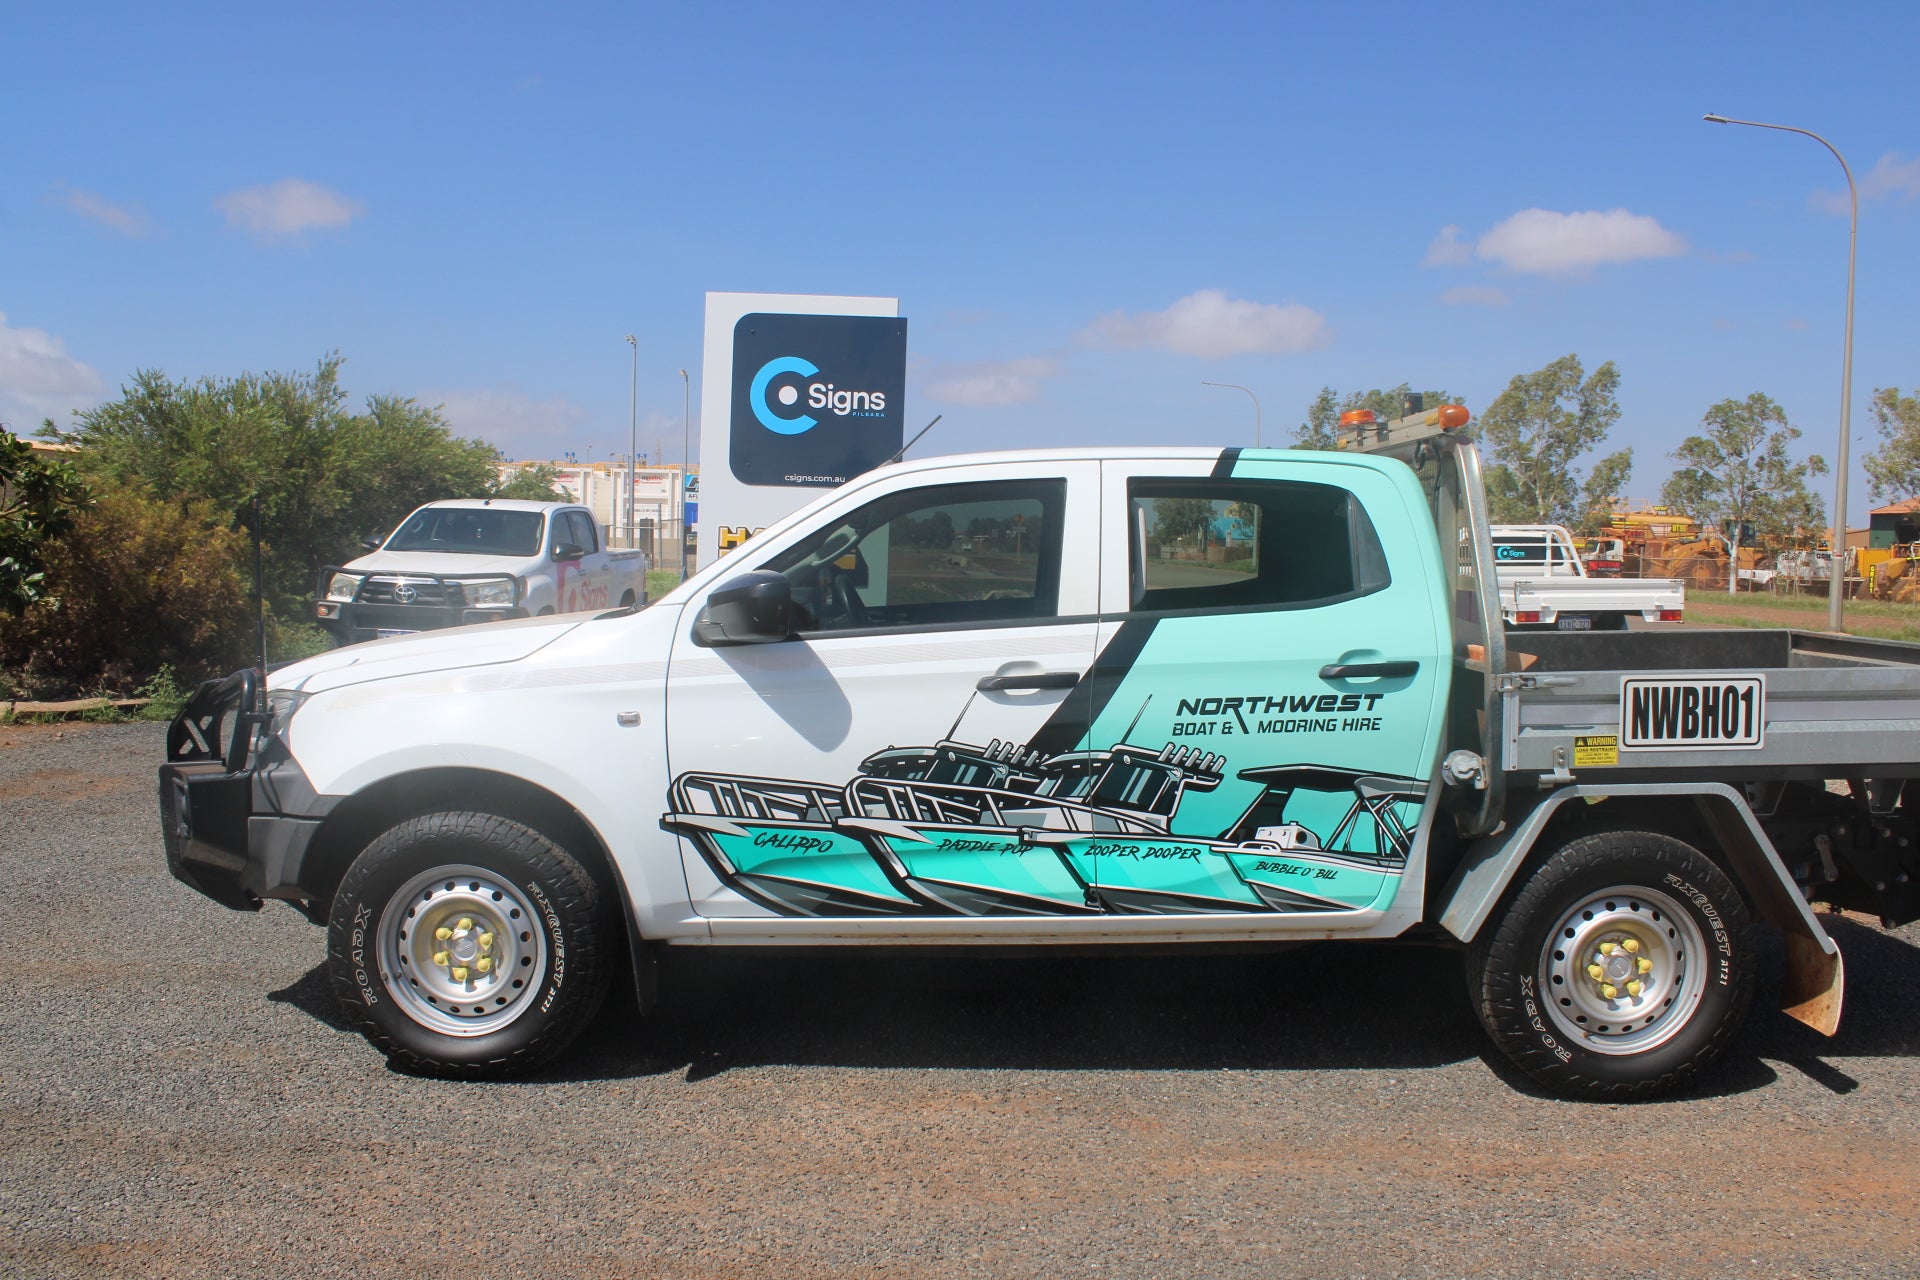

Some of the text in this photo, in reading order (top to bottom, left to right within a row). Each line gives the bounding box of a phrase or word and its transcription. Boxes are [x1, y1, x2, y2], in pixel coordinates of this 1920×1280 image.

[808, 383, 886, 416] Signs
[785, 473, 846, 483] csigns.com.au
[1631, 685, 1754, 740] NWBH01
[1172, 717, 1383, 736] BOAT & MOORING HIRE
[1587, 736, 1616, 746] WARNING
[753, 831, 834, 855] CALIPPO
[936, 838, 1035, 857] PADDLE POP
[1083, 844, 1202, 864] ZOOPER DOOPER
[1253, 860, 1301, 875] BUBBLE
[1315, 867, 1338, 880] BILL
[351, 903, 379, 1007] ROADX
[1519, 974, 1572, 1064] ROADX
